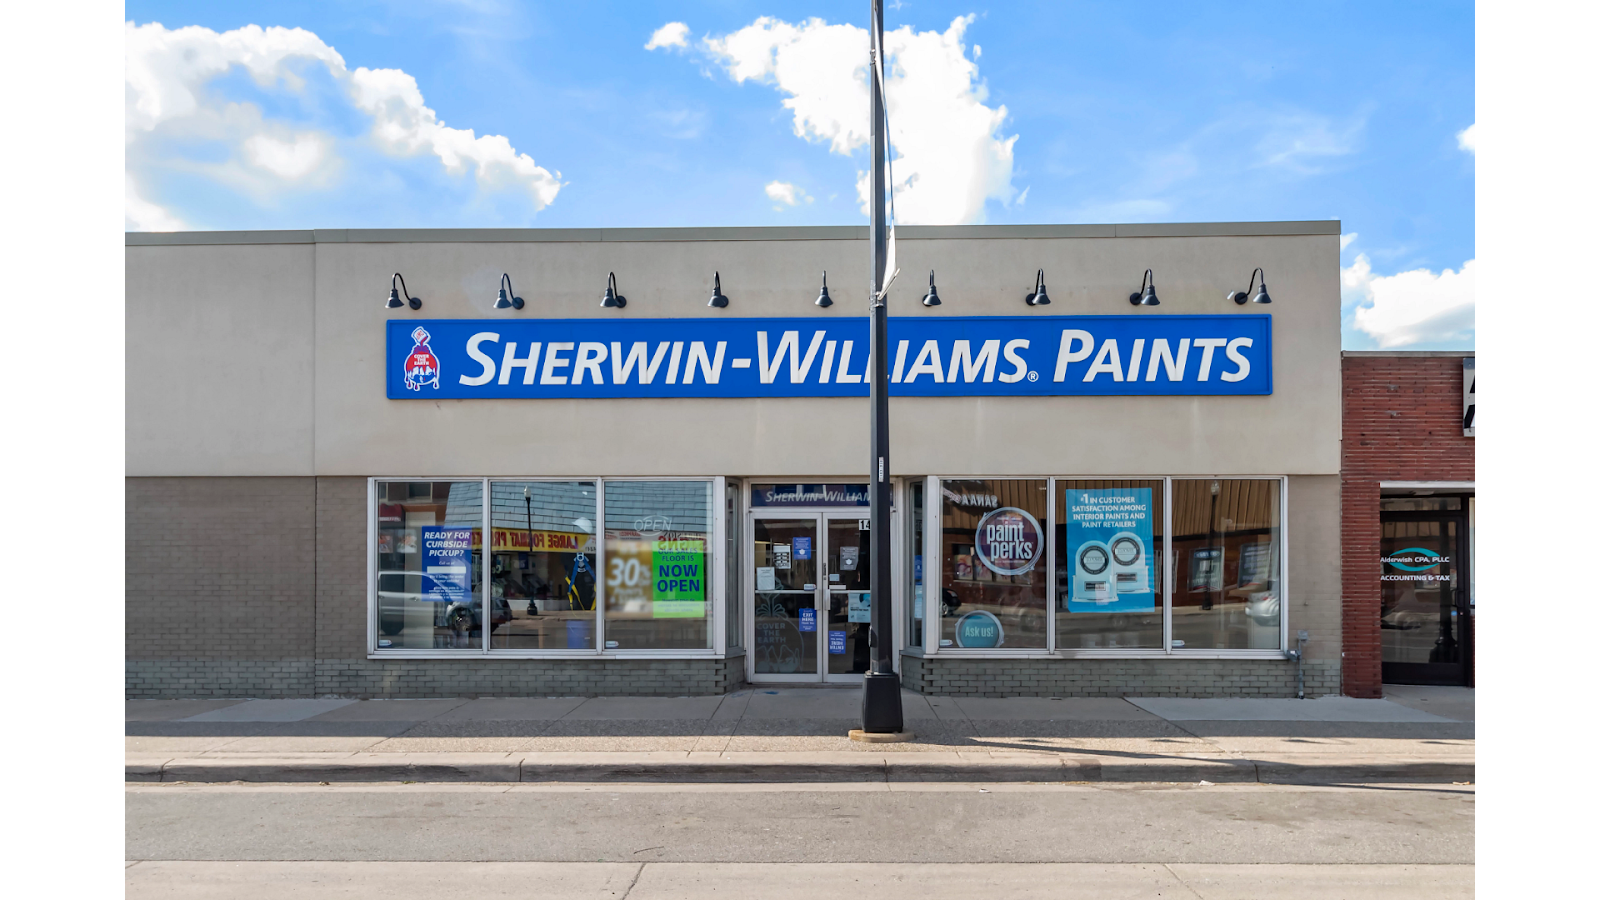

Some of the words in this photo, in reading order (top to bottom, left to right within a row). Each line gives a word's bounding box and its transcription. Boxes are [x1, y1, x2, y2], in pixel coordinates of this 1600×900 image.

[1054, 329, 1253, 383] PAINTS
[765, 490, 870, 502] SHERWIN-WILLIAM
[634, 519, 672, 532] OPEN
[986, 521, 1024, 544] paint
[426, 540, 468, 548] CURBSIDE
[991, 540, 1032, 561] perks
[659, 564, 698, 577] NOW
[657, 579, 700, 592] OPEN
[965, 626, 979, 637] Ask
[981, 626, 994, 637] us!
